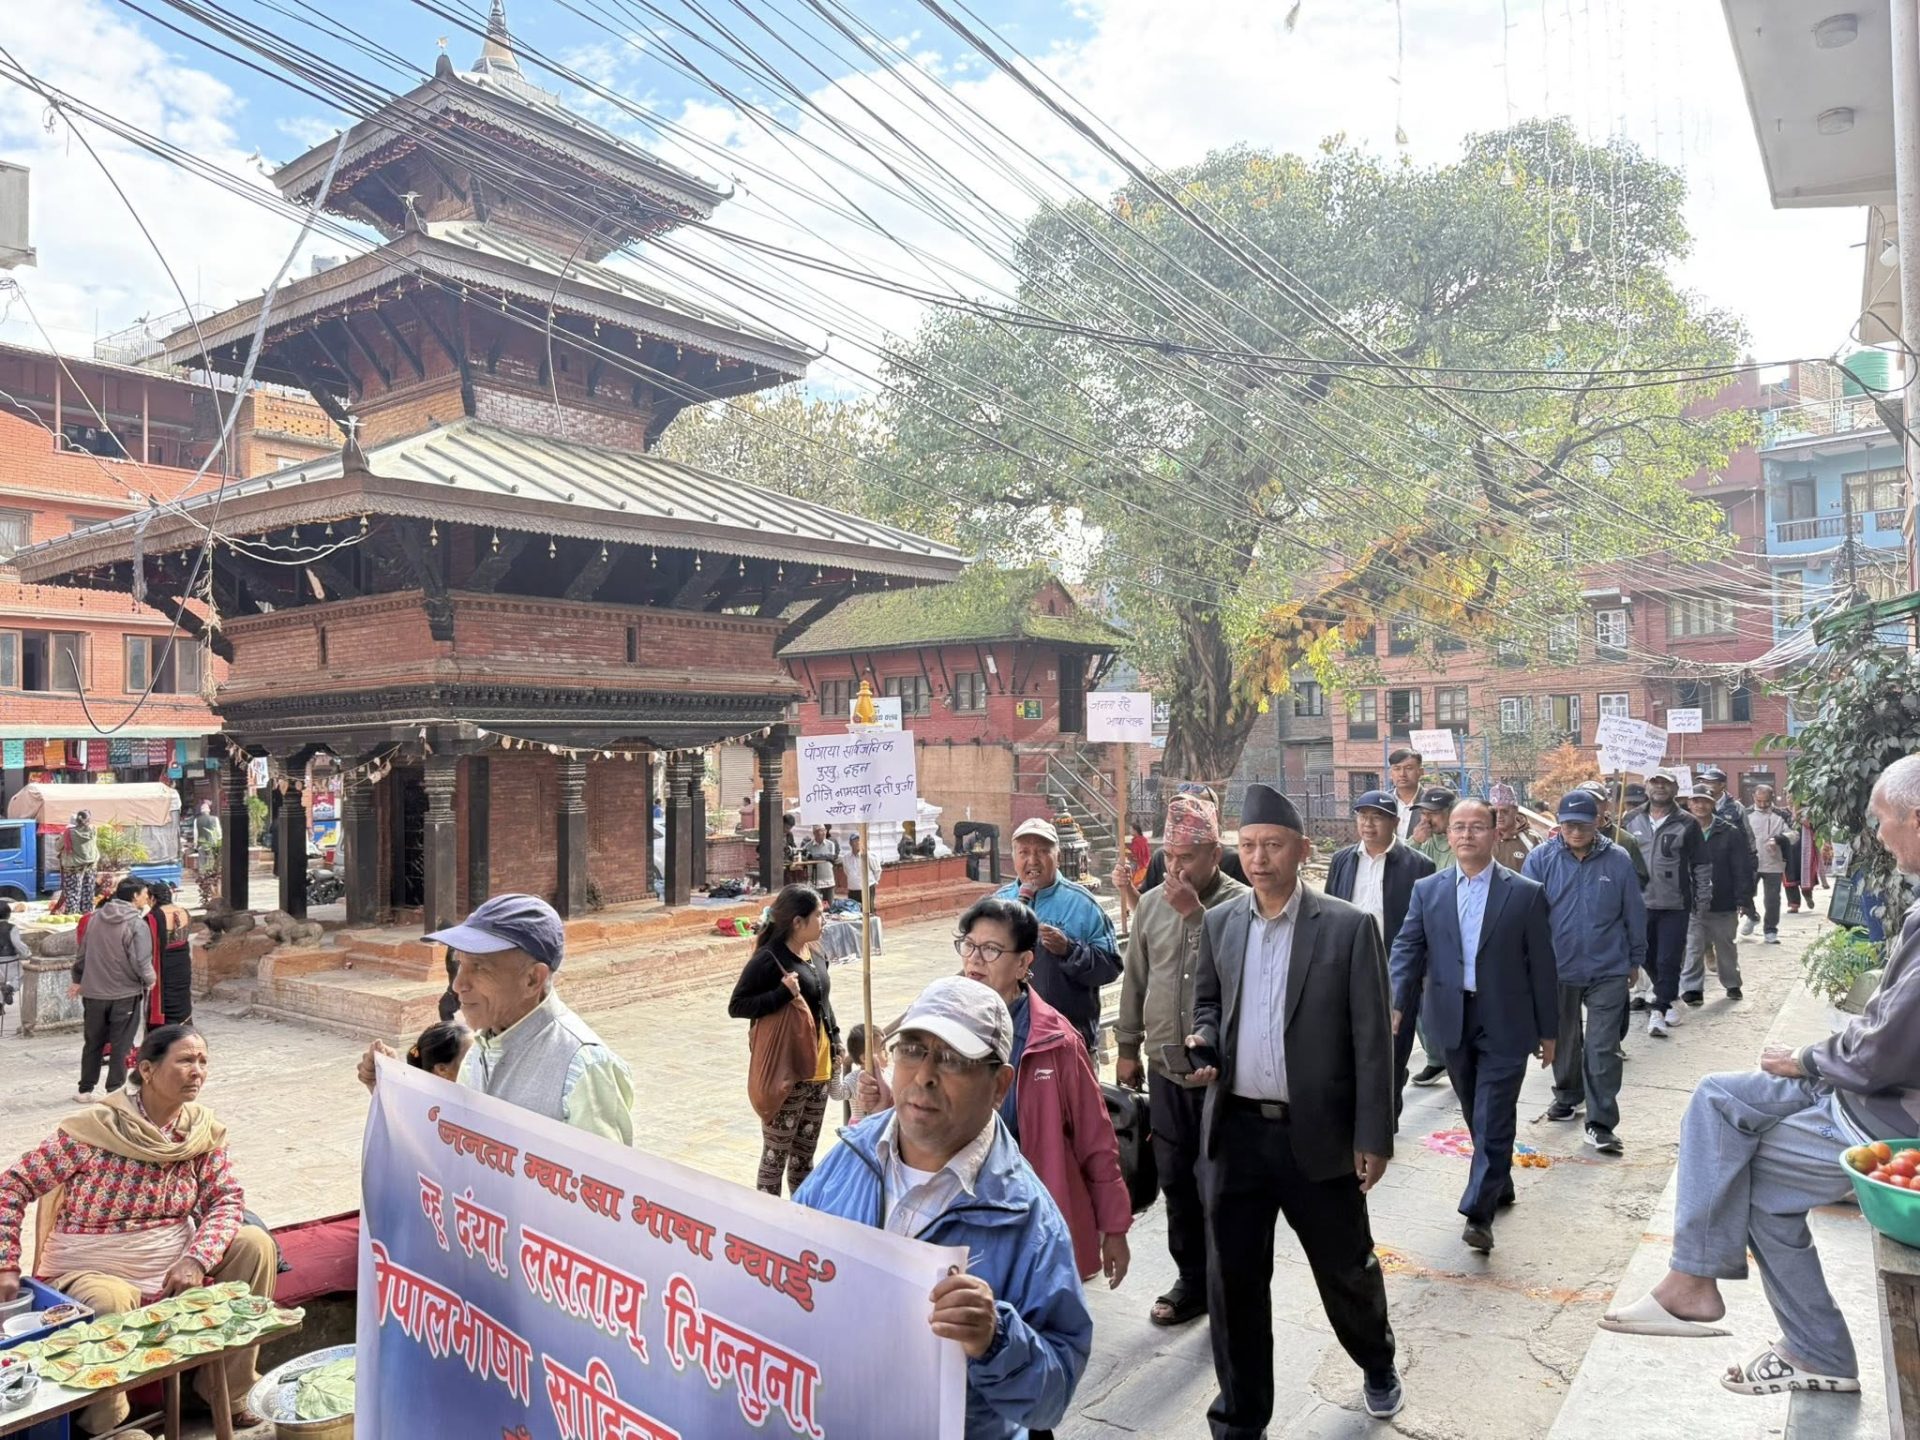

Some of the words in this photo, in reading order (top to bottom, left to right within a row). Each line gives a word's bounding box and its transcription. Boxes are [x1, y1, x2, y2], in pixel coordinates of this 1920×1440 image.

[632, 1195, 716, 1261] भाषा
[662, 1272, 825, 1440] भिन्तुना
[1752, 1379, 1839, 1394] SPORT
